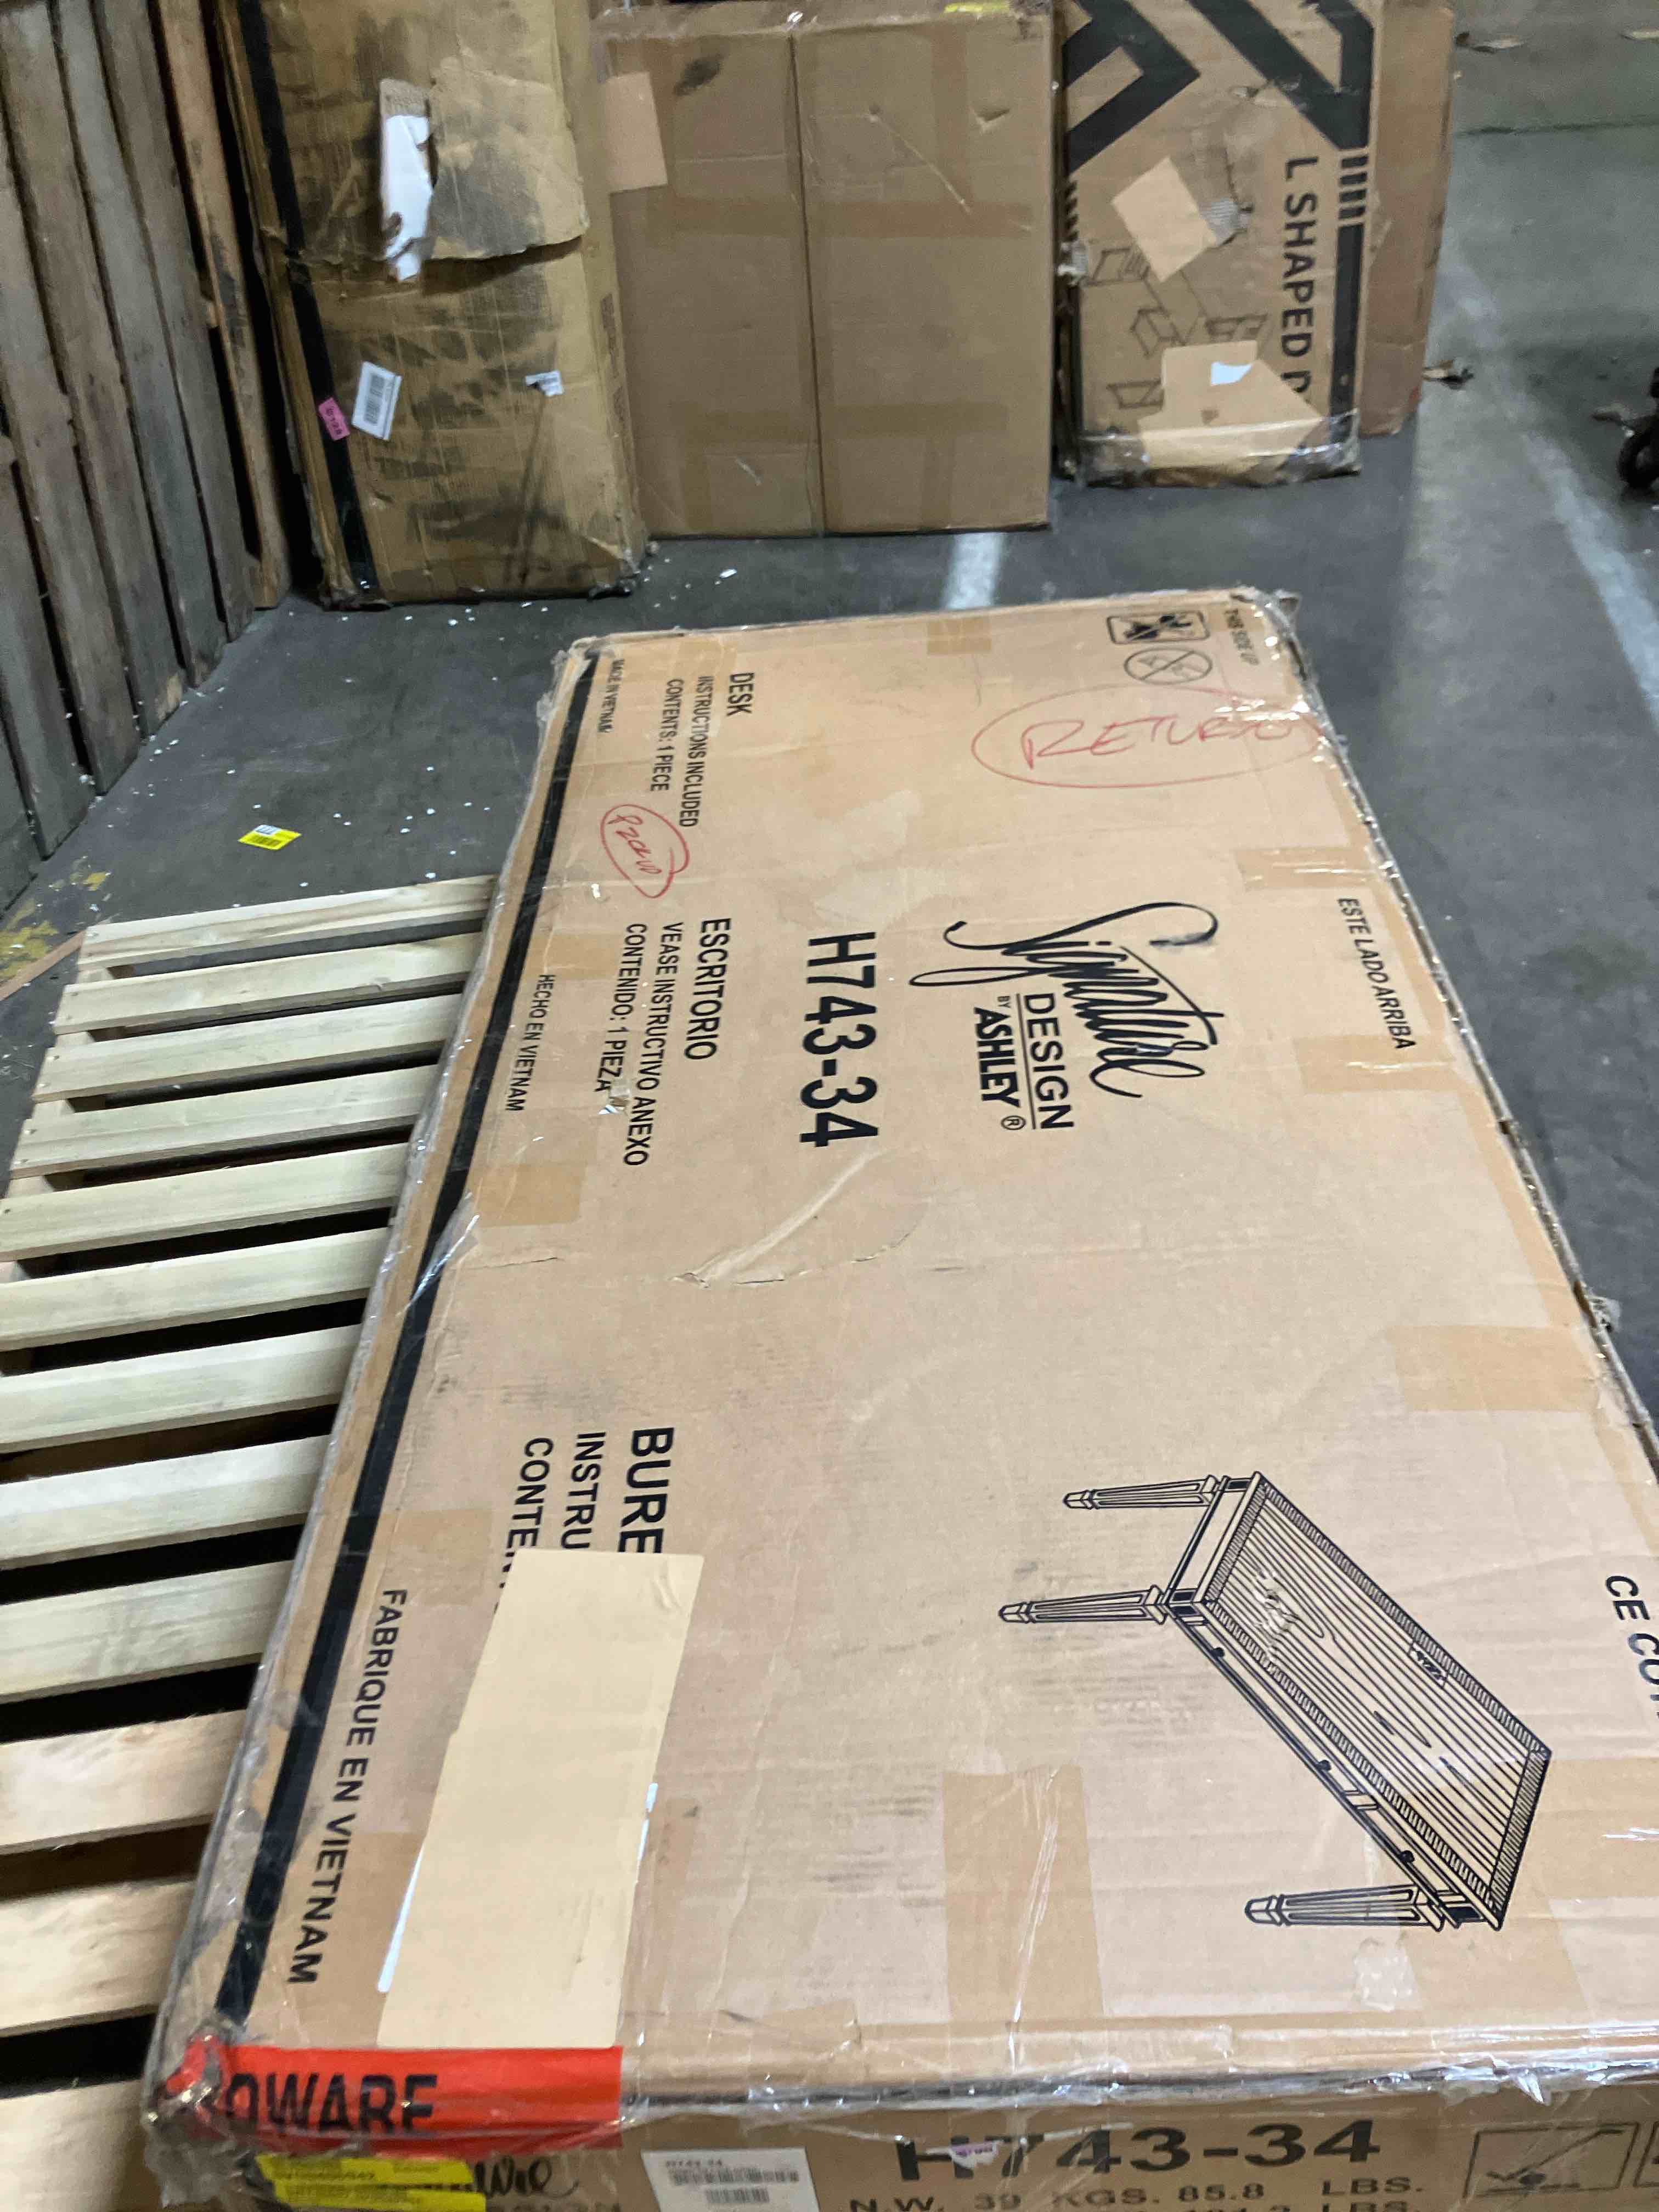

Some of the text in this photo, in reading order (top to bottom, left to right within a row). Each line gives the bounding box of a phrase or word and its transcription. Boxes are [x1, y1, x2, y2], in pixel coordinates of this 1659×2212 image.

[1280, 192, 1318, 358] SHAPED
[658, 678, 685, 742] CONTENTS:
[679, 675, 714, 827] INSTRUCTIONS INCLUDED
[726, 672, 755, 717] DESK
[650, 755, 675, 792] PIECE
[610, 923, 649, 1022] CONTENIDO:
[684, 918, 732, 1060] ESCRITORIO
[799, 931, 879, 1148] H743-34
[1337, 898, 1417, 1049] ESTE LADO ARRIBA
[505, 974, 556, 1111] HECHO EN VIETNAM
[623, 921, 685, 1166] VEASE INSTRUCTIVO ANEXO
[974, 995, 1021, 1108] BY ASHLEY
[1024, 992, 1075, 1130] DESIGN
[1605, 1575, 1651, 1621] CE
[287, 1588, 408, 1985] FABRIQUE EN VIETNAM
[895, 2119, 1380, 2180] H743-34
[1321, 2177, 1423, 2195] LBS.
